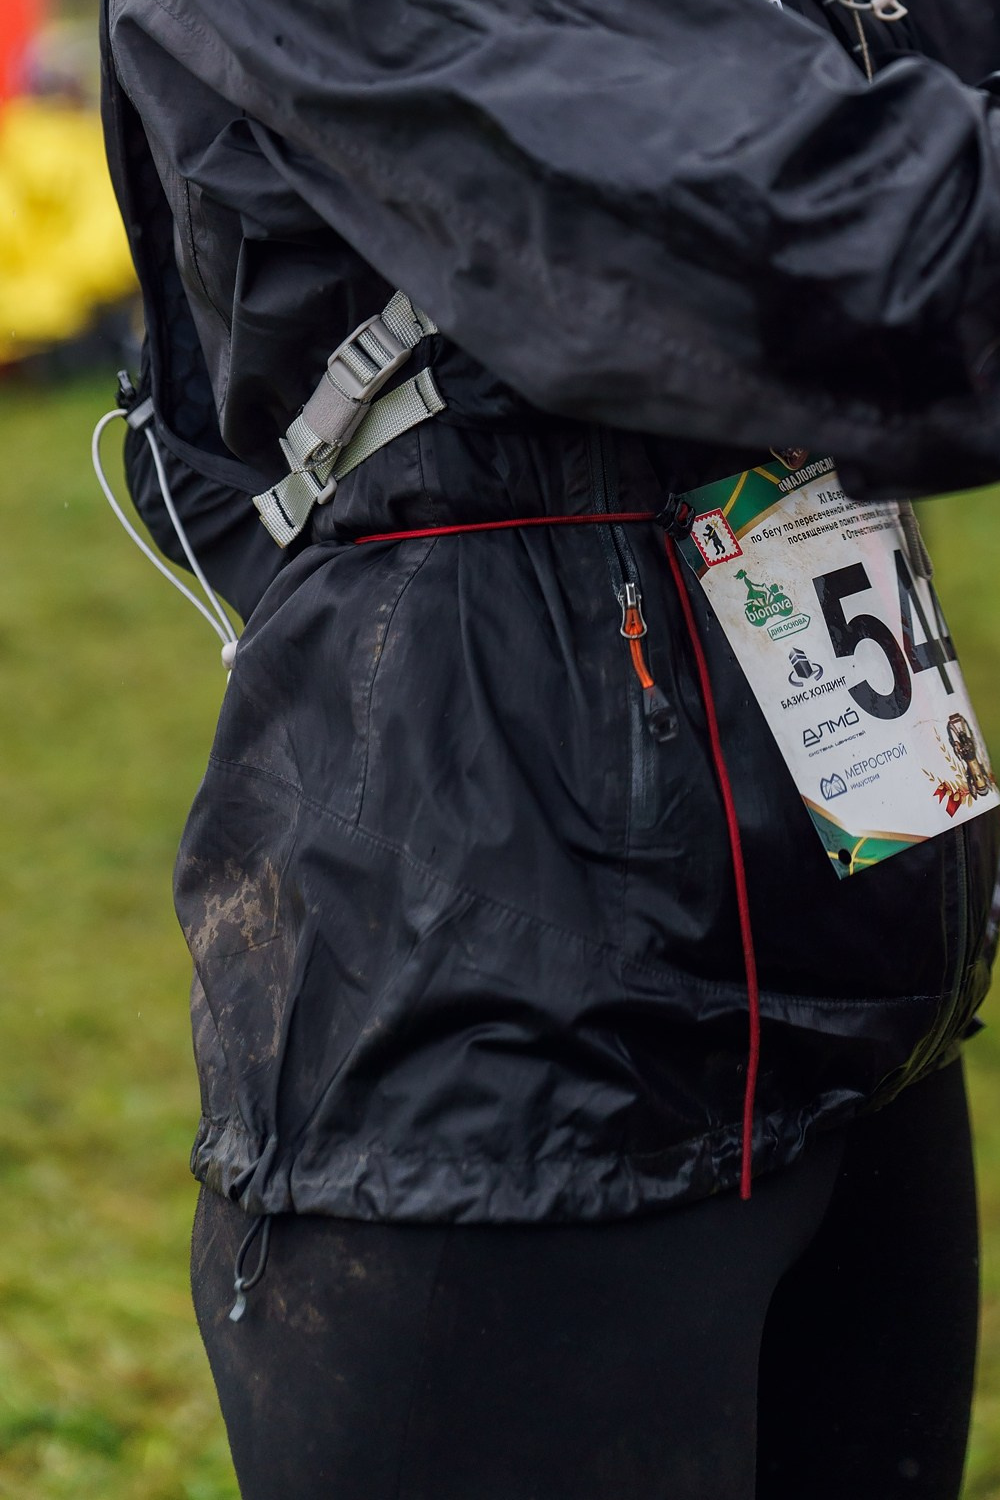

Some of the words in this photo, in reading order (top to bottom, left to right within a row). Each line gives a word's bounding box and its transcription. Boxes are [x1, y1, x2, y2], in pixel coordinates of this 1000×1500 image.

[750, 534, 763, 544] по
[762, 525, 783, 541] бегу
[783, 521, 795, 533] по
[794, 502, 846, 528] пересеченной
[787, 521, 839, 545] посвященные
[745, 598, 792, 623] bionova
[770, 626, 784, 638] ДНЯ
[783, 617, 808, 631] ОСНОВА
[780, 691, 810, 710] БАЗИС
[809, 675, 847, 697] ХОЛДИНГ
[844, 742, 908, 780] МЕТРОСТРОЙ
